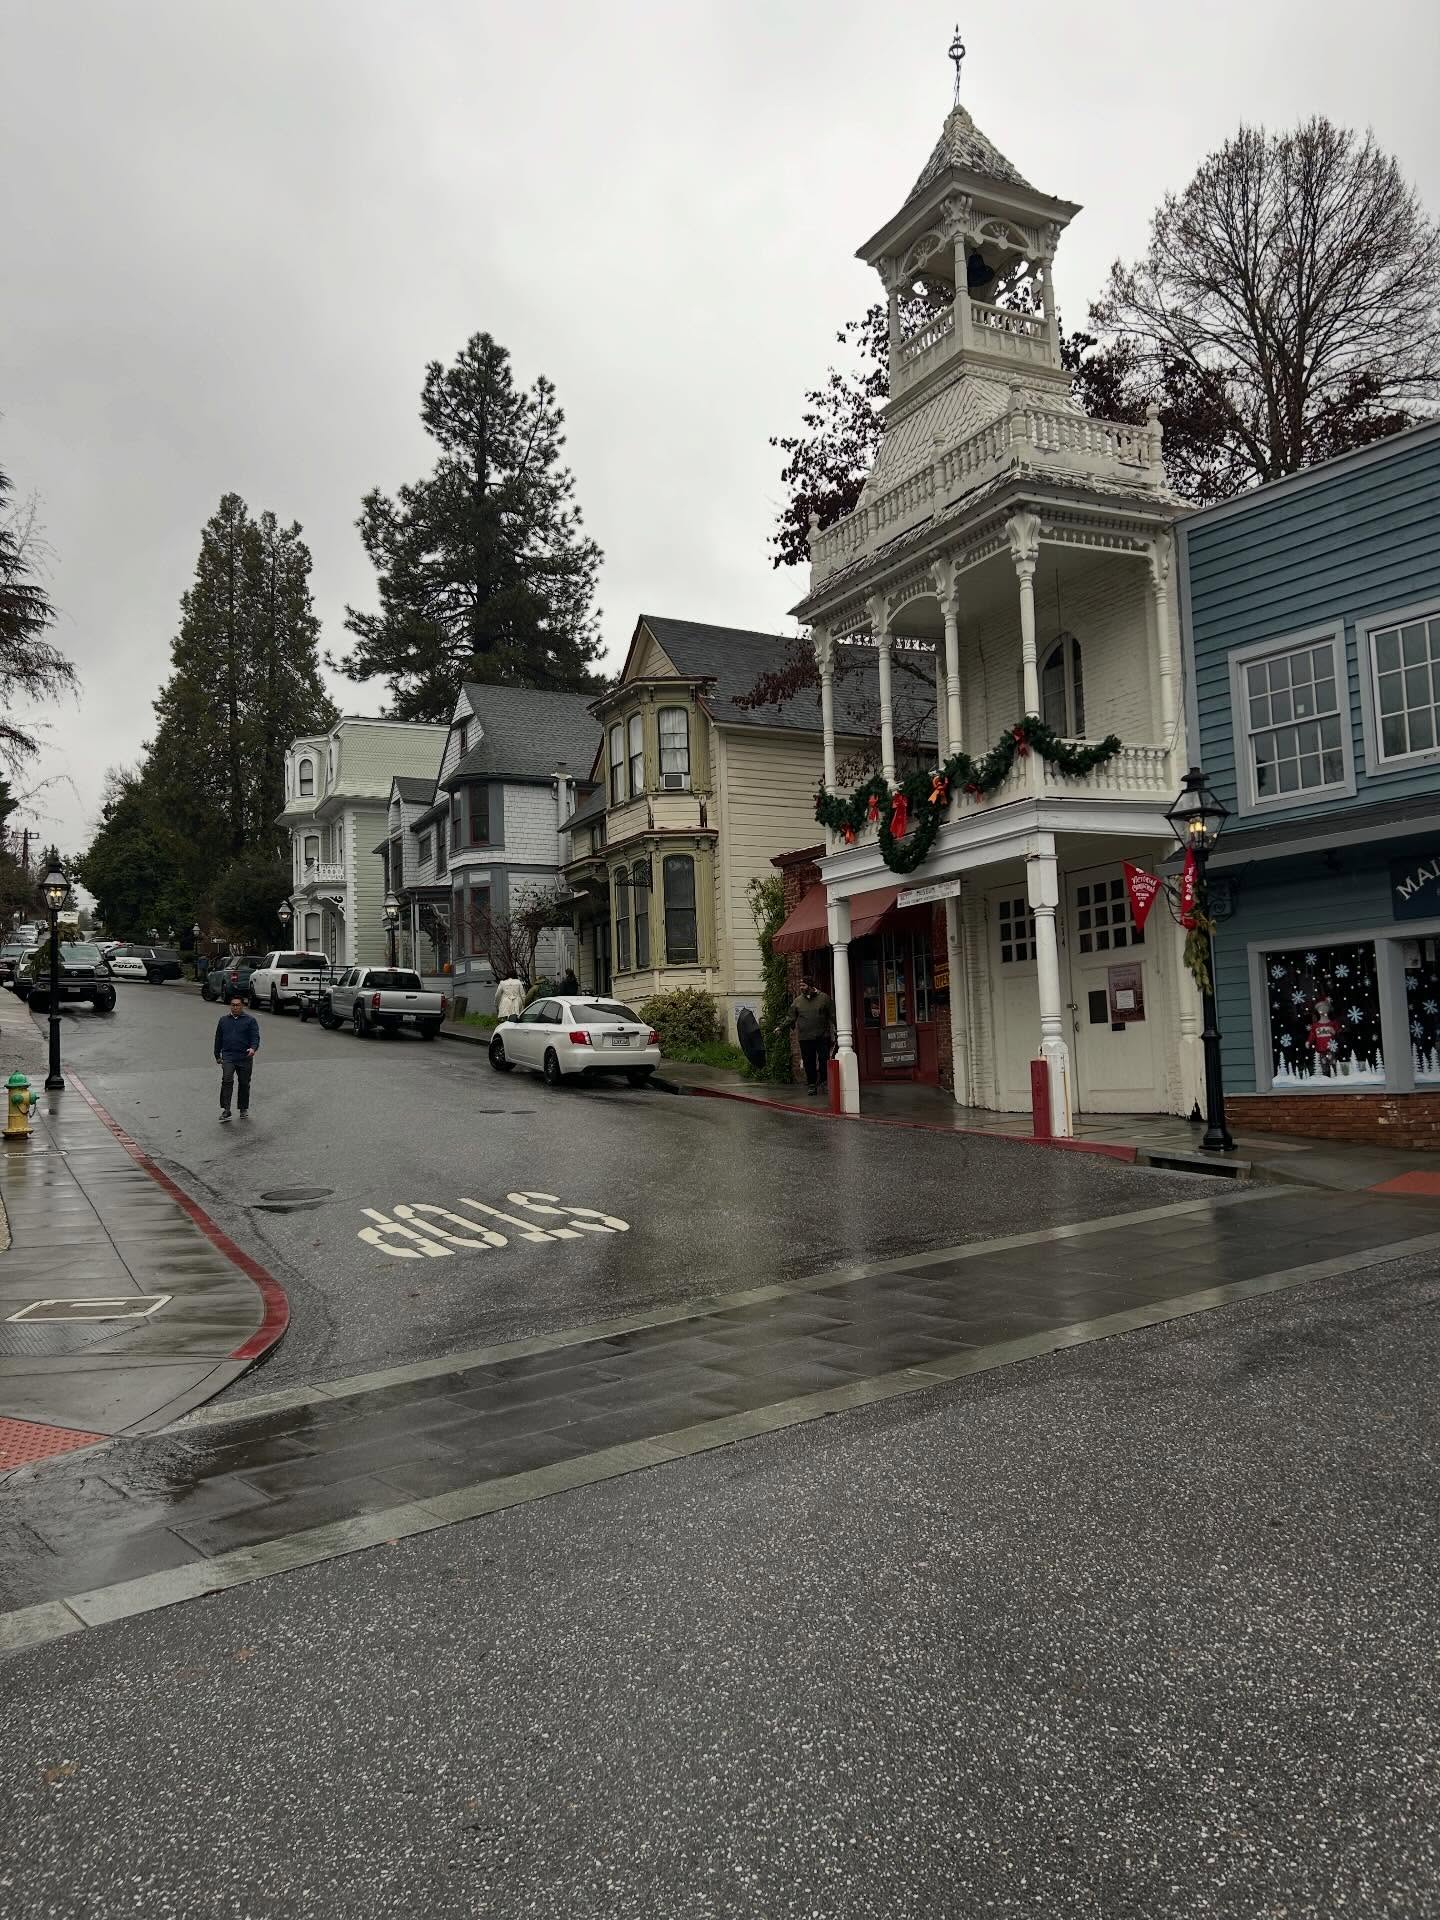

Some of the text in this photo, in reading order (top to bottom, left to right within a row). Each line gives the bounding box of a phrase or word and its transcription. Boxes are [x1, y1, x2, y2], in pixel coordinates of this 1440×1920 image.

[1396, 857, 1440, 900] MAI
[936, 973, 949, 988] OPE
[357, 1191, 629, 1257] STOP
